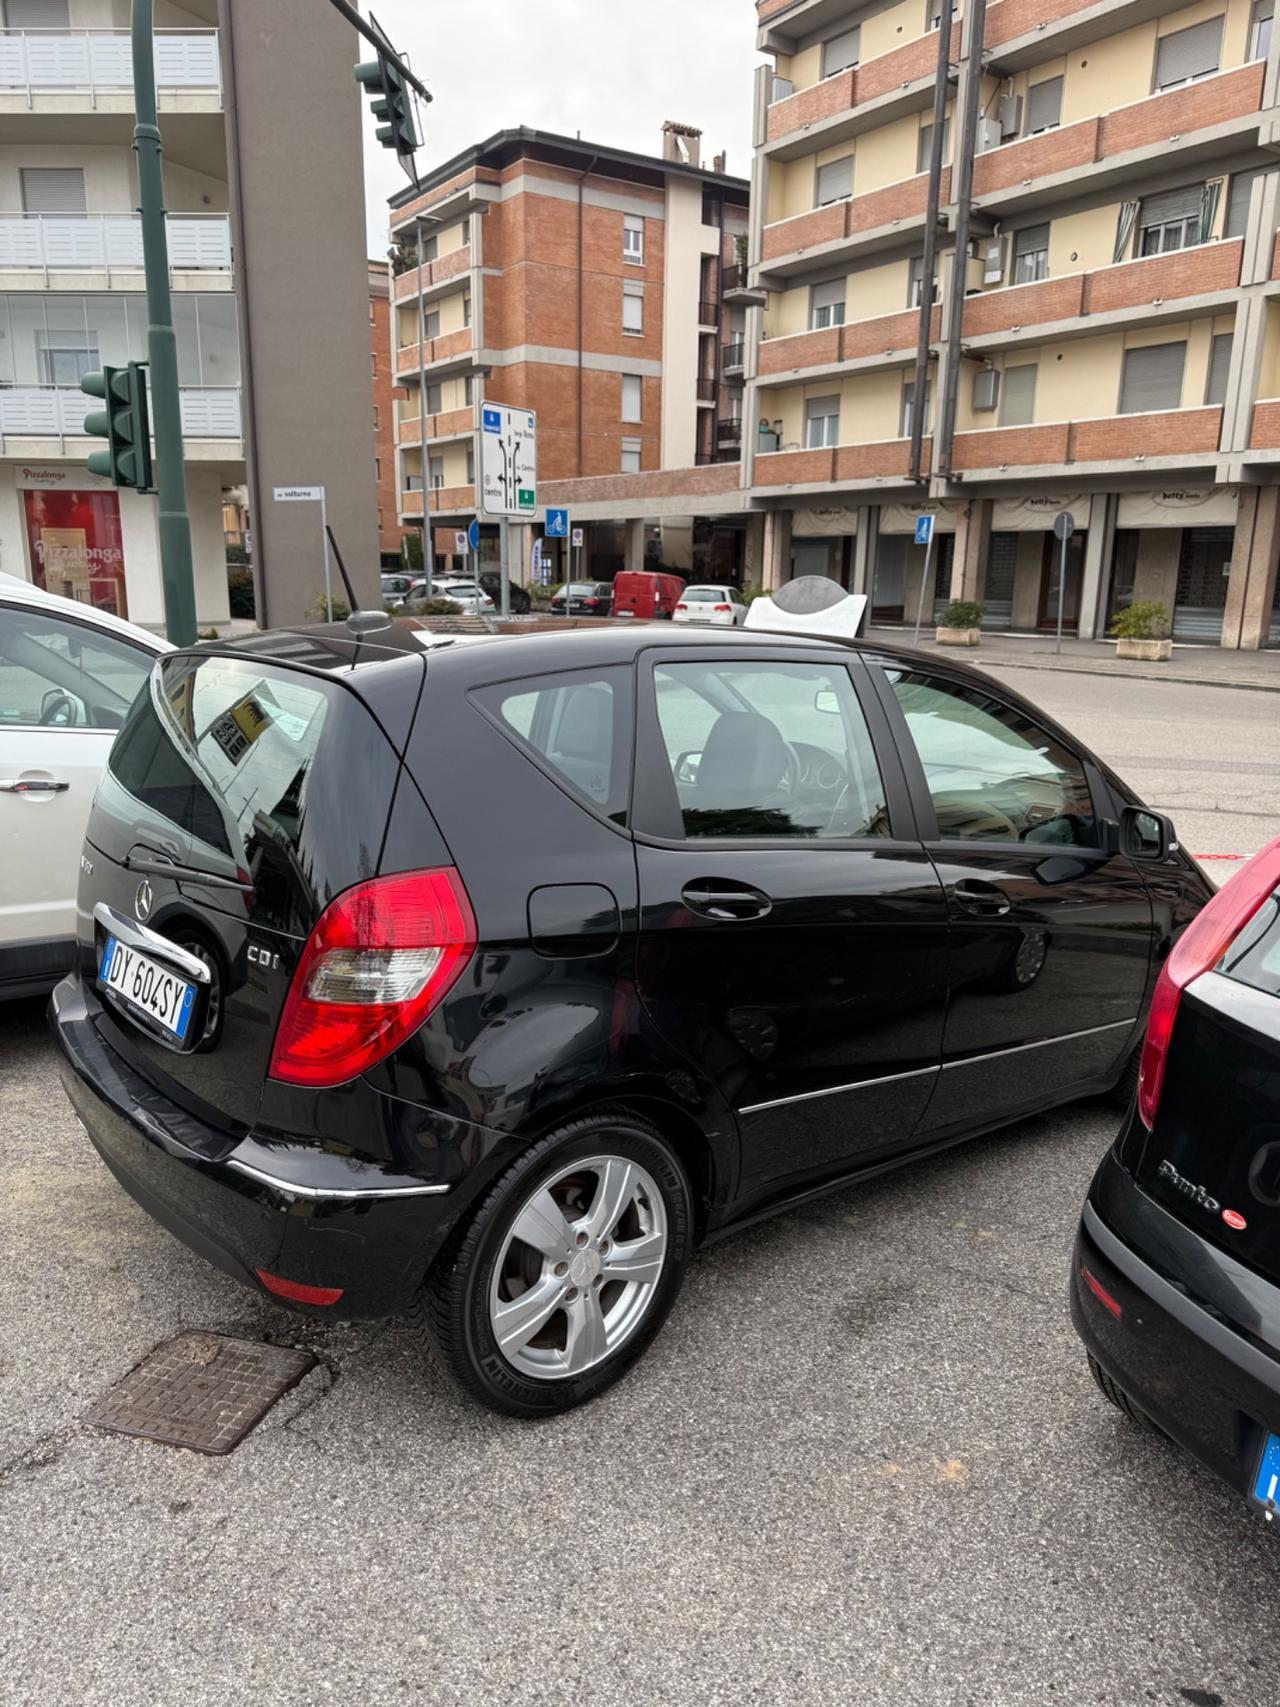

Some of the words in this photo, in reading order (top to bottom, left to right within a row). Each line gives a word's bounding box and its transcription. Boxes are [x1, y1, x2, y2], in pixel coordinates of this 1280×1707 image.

[22, 468, 66, 481] Pizzalonga
[284, 490, 312, 498] volturno
[34, 541, 122, 563] Pizzalonga
[247, 945, 280, 970] CDI
[110, 945, 133, 988] DY
[133, 959, 184, 1025] 604SY
[1158, 1159, 1221, 1212] Punto
